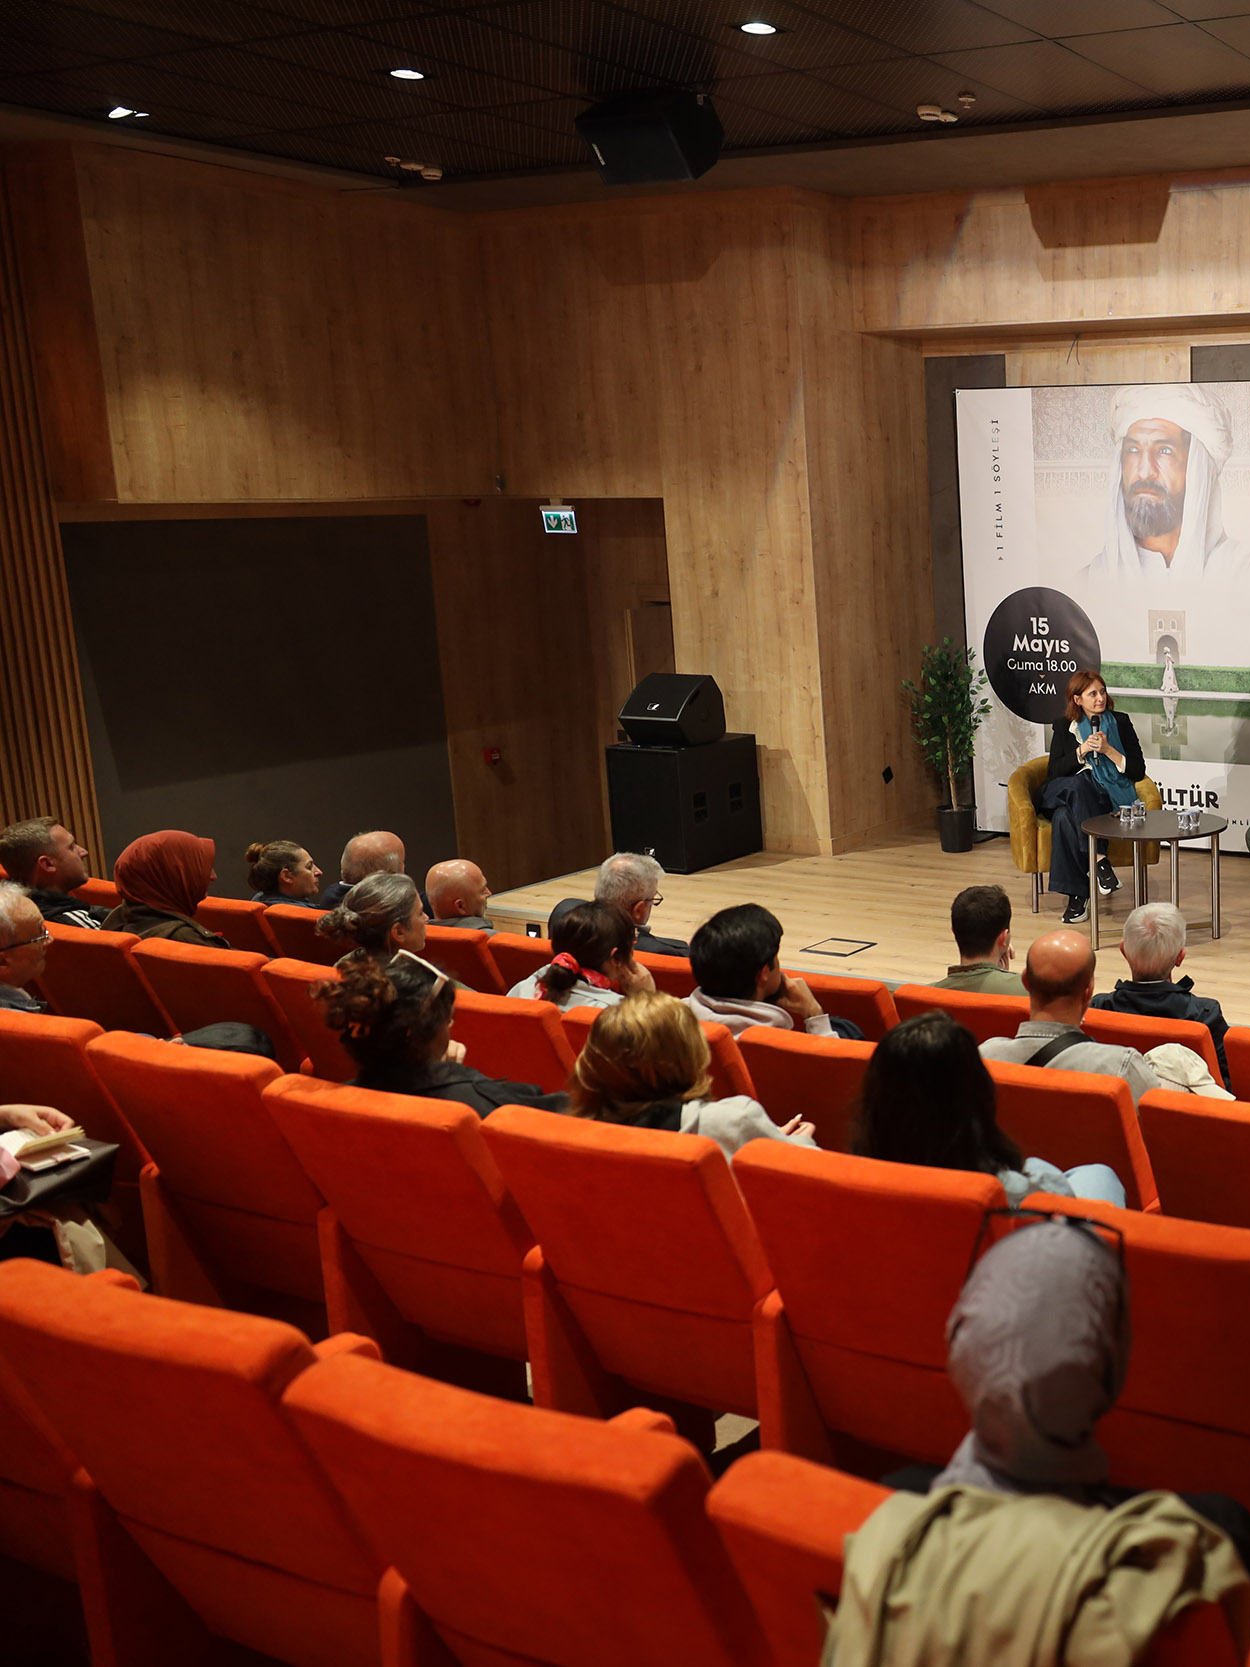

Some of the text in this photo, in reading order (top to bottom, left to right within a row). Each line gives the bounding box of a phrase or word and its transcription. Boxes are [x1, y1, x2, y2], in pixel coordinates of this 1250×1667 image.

[990, 419, 1001, 482] SÖYLEŞİ
[994, 503, 1003, 538] FİLM
[1030, 616, 1050, 636] 15
[1012, 633, 1070, 658] Mayıs
[1007, 658, 1077, 673] Cuma 18.00
[1028, 682, 1057, 695] AKM
[1154, 781, 1219, 809] ÜLTÜR
